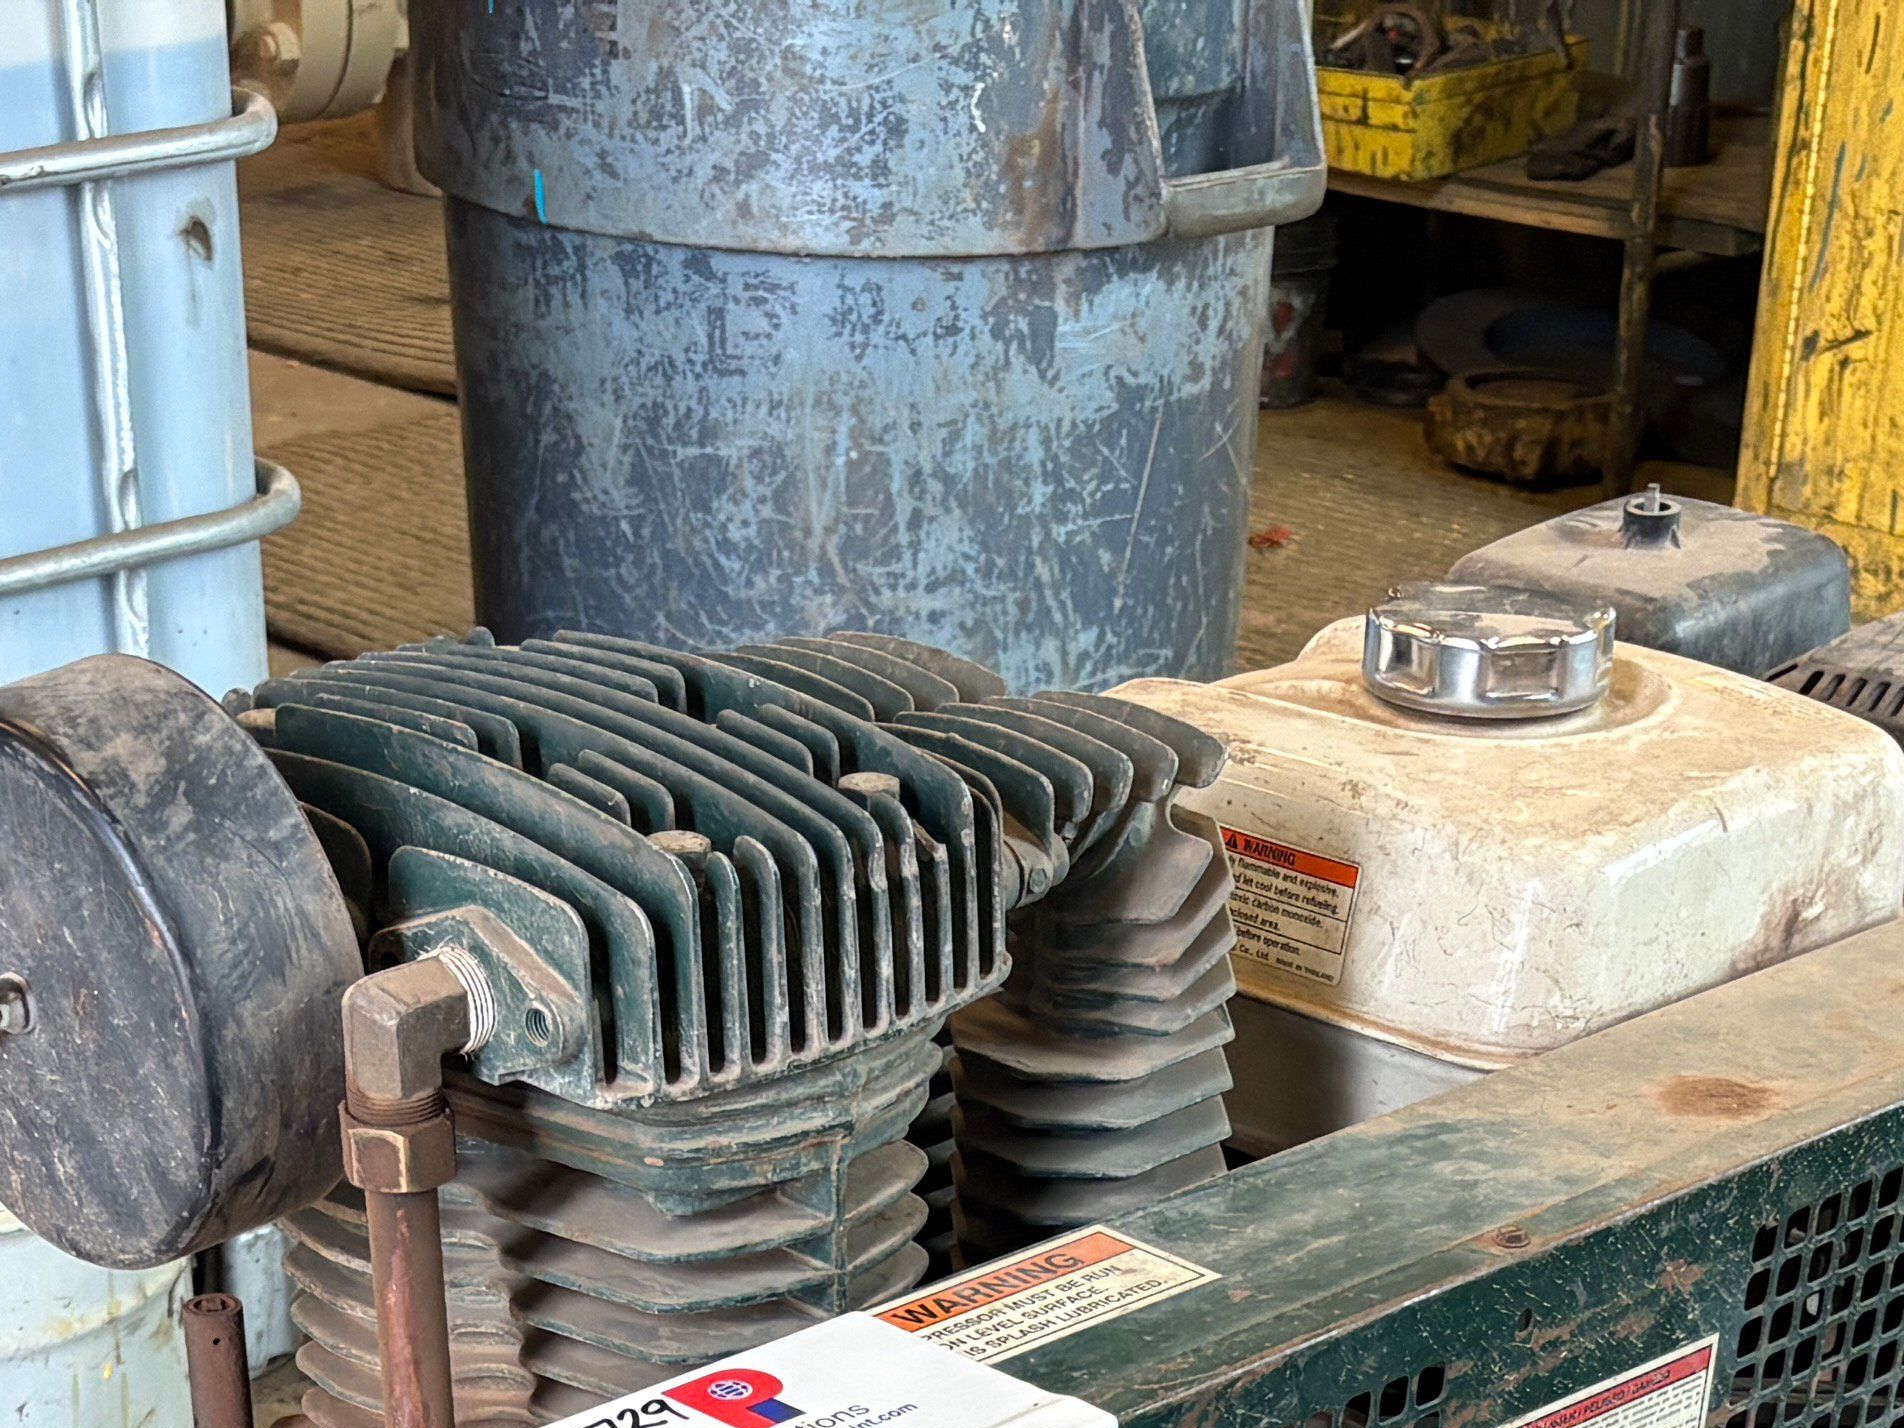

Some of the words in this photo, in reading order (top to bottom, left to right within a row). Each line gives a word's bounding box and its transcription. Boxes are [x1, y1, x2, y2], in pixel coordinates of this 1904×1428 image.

[891, 1251, 1085, 1328] WARNING
[963, 1345, 987, 1357] IS
[985, 1319, 1058, 1349] SPLASH
[1056, 1279, 1169, 1322] LUBRICATED.
[1003, 1288, 1056, 1312] MUST
[1055, 1279, 1082, 1293] BE
[1081, 1264, 1123, 1283] RUN
[965, 1318, 1025, 1341] LEVEL
